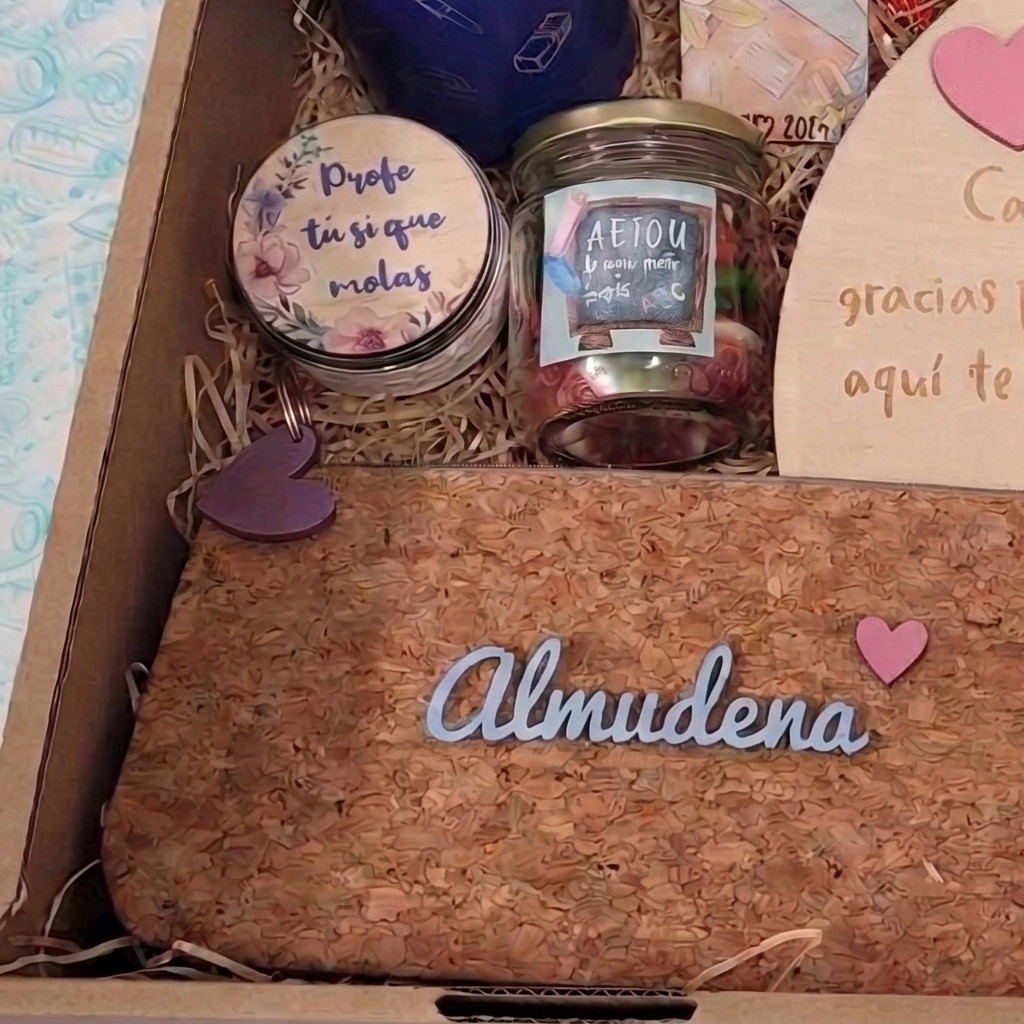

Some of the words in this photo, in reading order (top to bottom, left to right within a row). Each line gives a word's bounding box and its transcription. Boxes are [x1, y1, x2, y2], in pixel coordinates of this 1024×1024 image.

[320, 156, 416, 197] Profe
[300, 215, 346, 250] tú
[383, 212, 447, 250] que
[329, 258, 431, 298] molas
[839, 277, 998, 327] gracias
[844, 352, 944, 418] aquí
[968, 348, 1013, 402] te
[426, 637, 871, 756] Almudena
